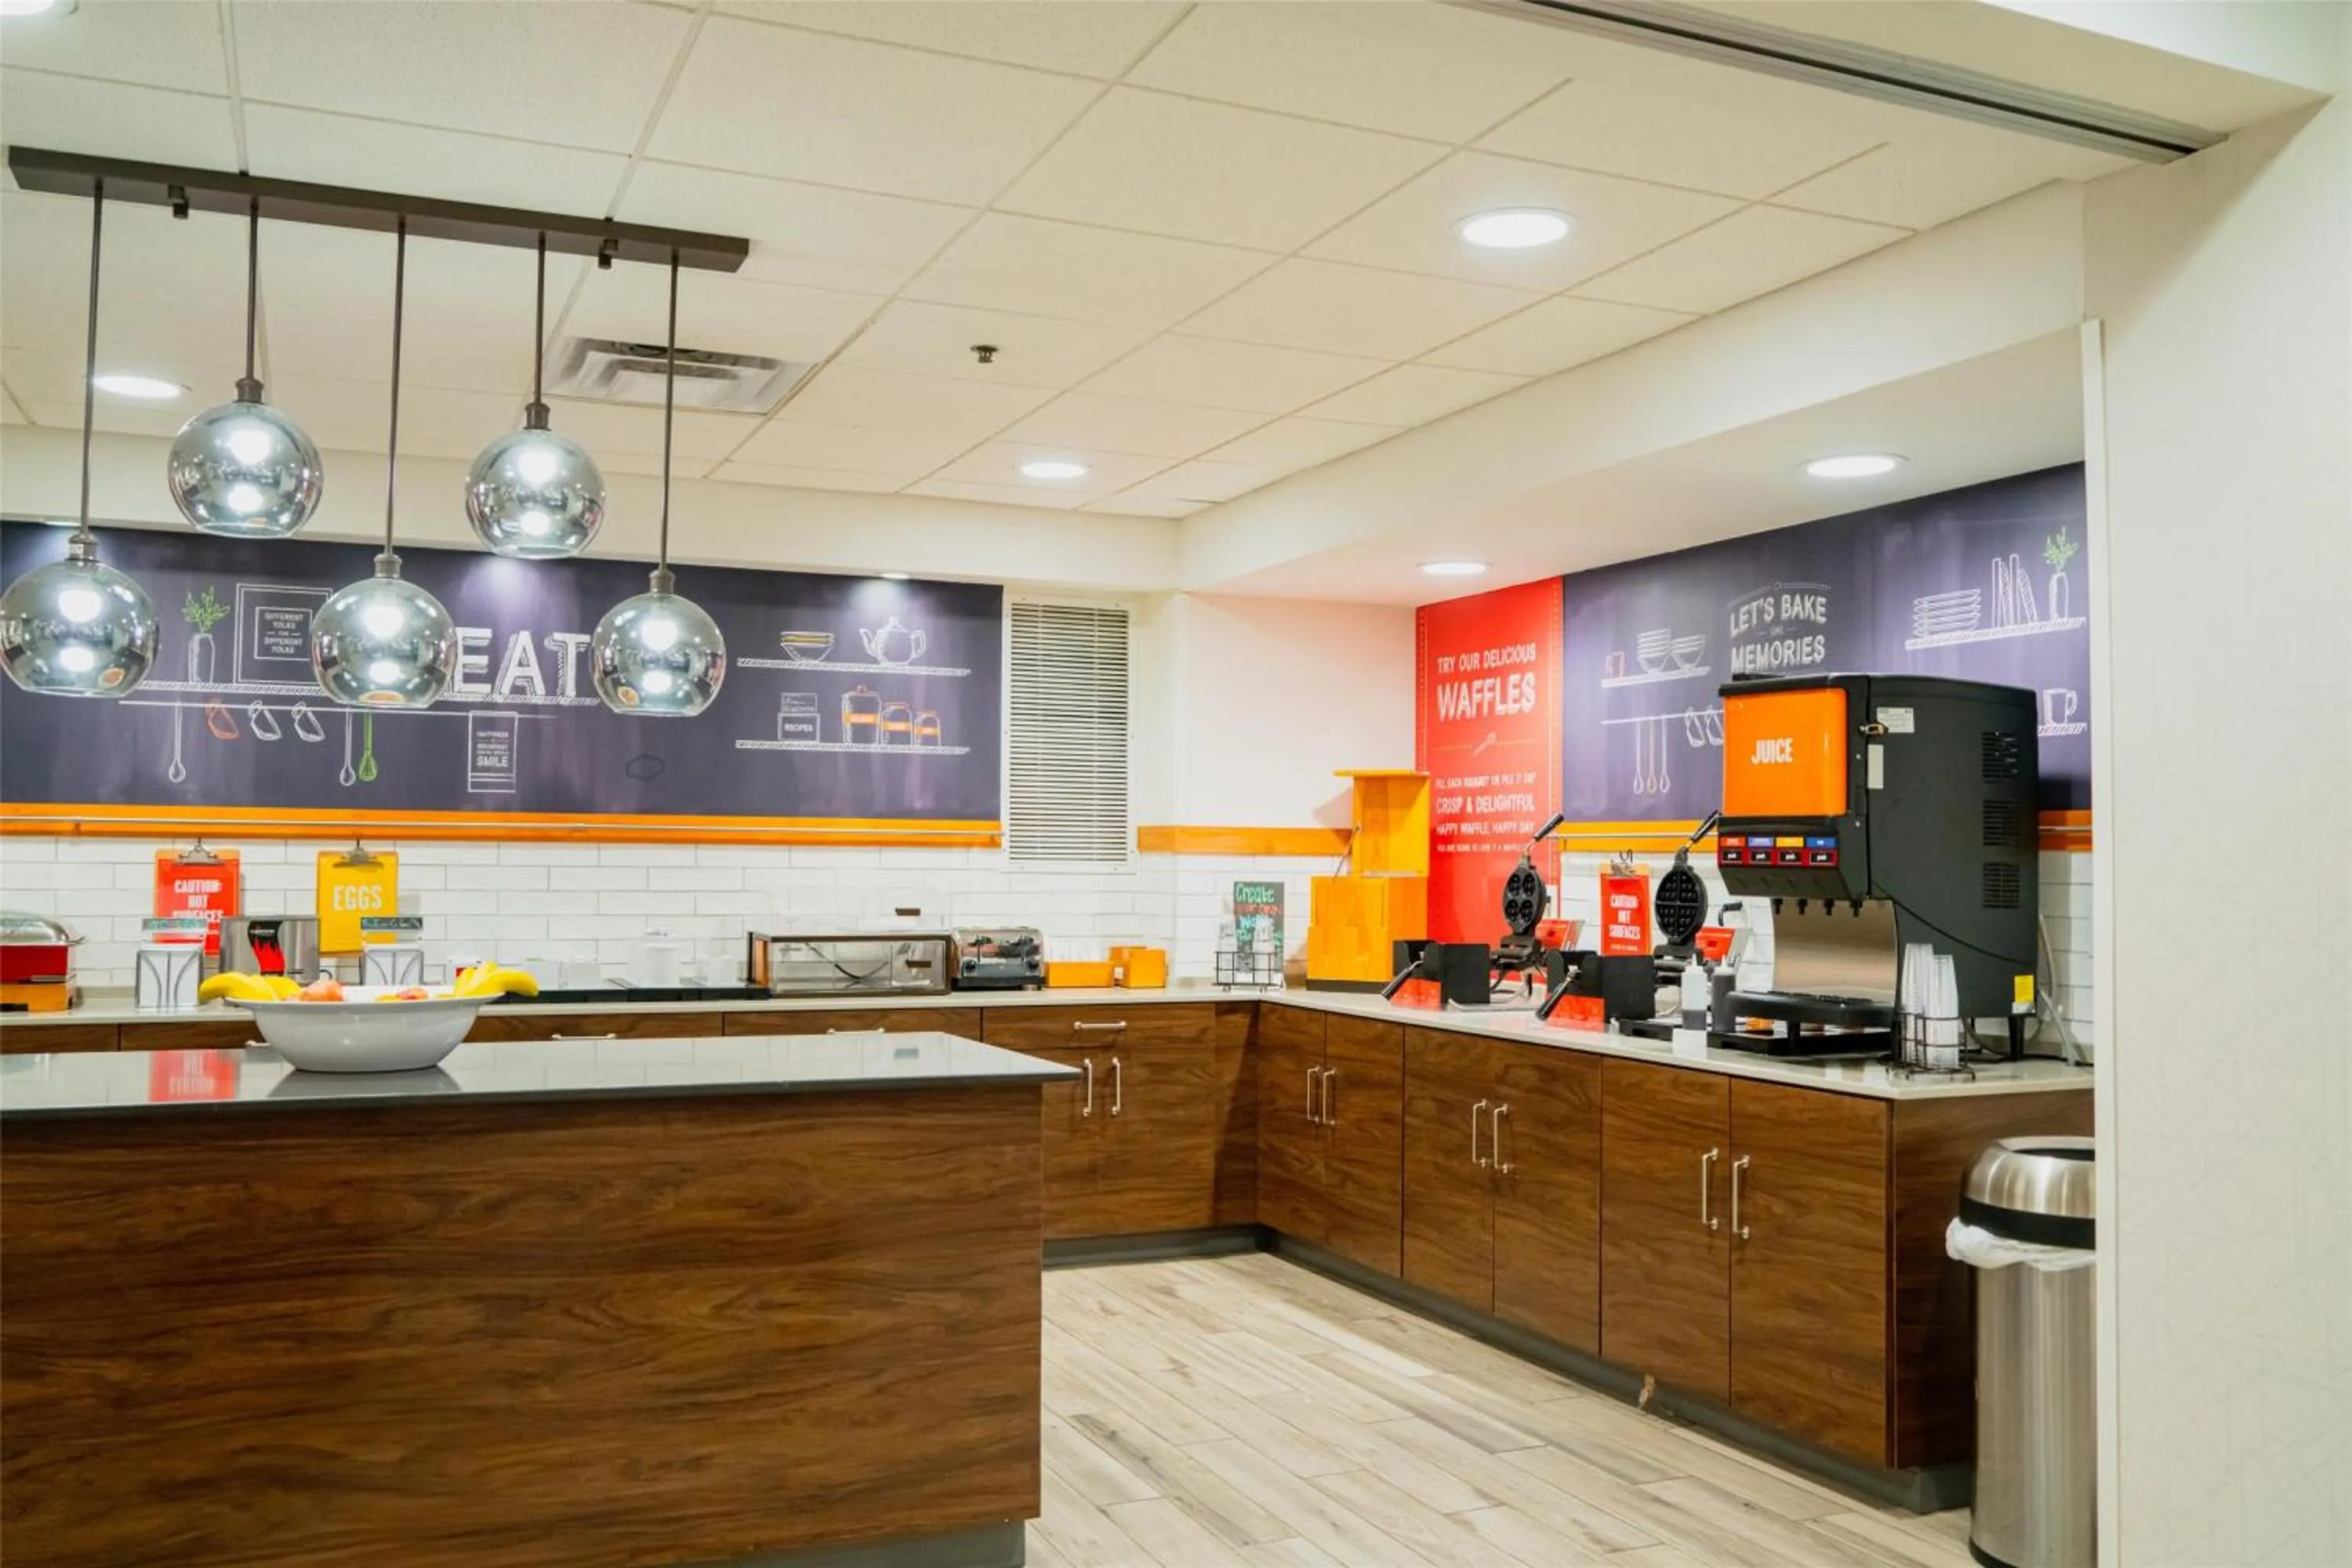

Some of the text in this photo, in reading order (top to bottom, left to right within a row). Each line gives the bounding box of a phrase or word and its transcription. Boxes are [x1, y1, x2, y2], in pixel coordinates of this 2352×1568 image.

[1730, 593, 1828, 639] LET'S BAKE
[450, 626, 592, 697] EAT
[1437, 641, 1536, 674] TRY OUR DELICIOUS
[1731, 634, 1825, 673] MEMORIES
[1437, 671, 1536, 723] WAFFLES
[477, 755, 509, 768] SMILE
[1751, 738, 1794, 764] JUICE
[1436, 796, 1463, 815] CRISP
[1475, 793, 1536, 813] DELIGHTFUL
[187, 895, 208, 909] HOT
[332, 885, 383, 911] EGGS
[1236, 883, 1275, 904] Create
